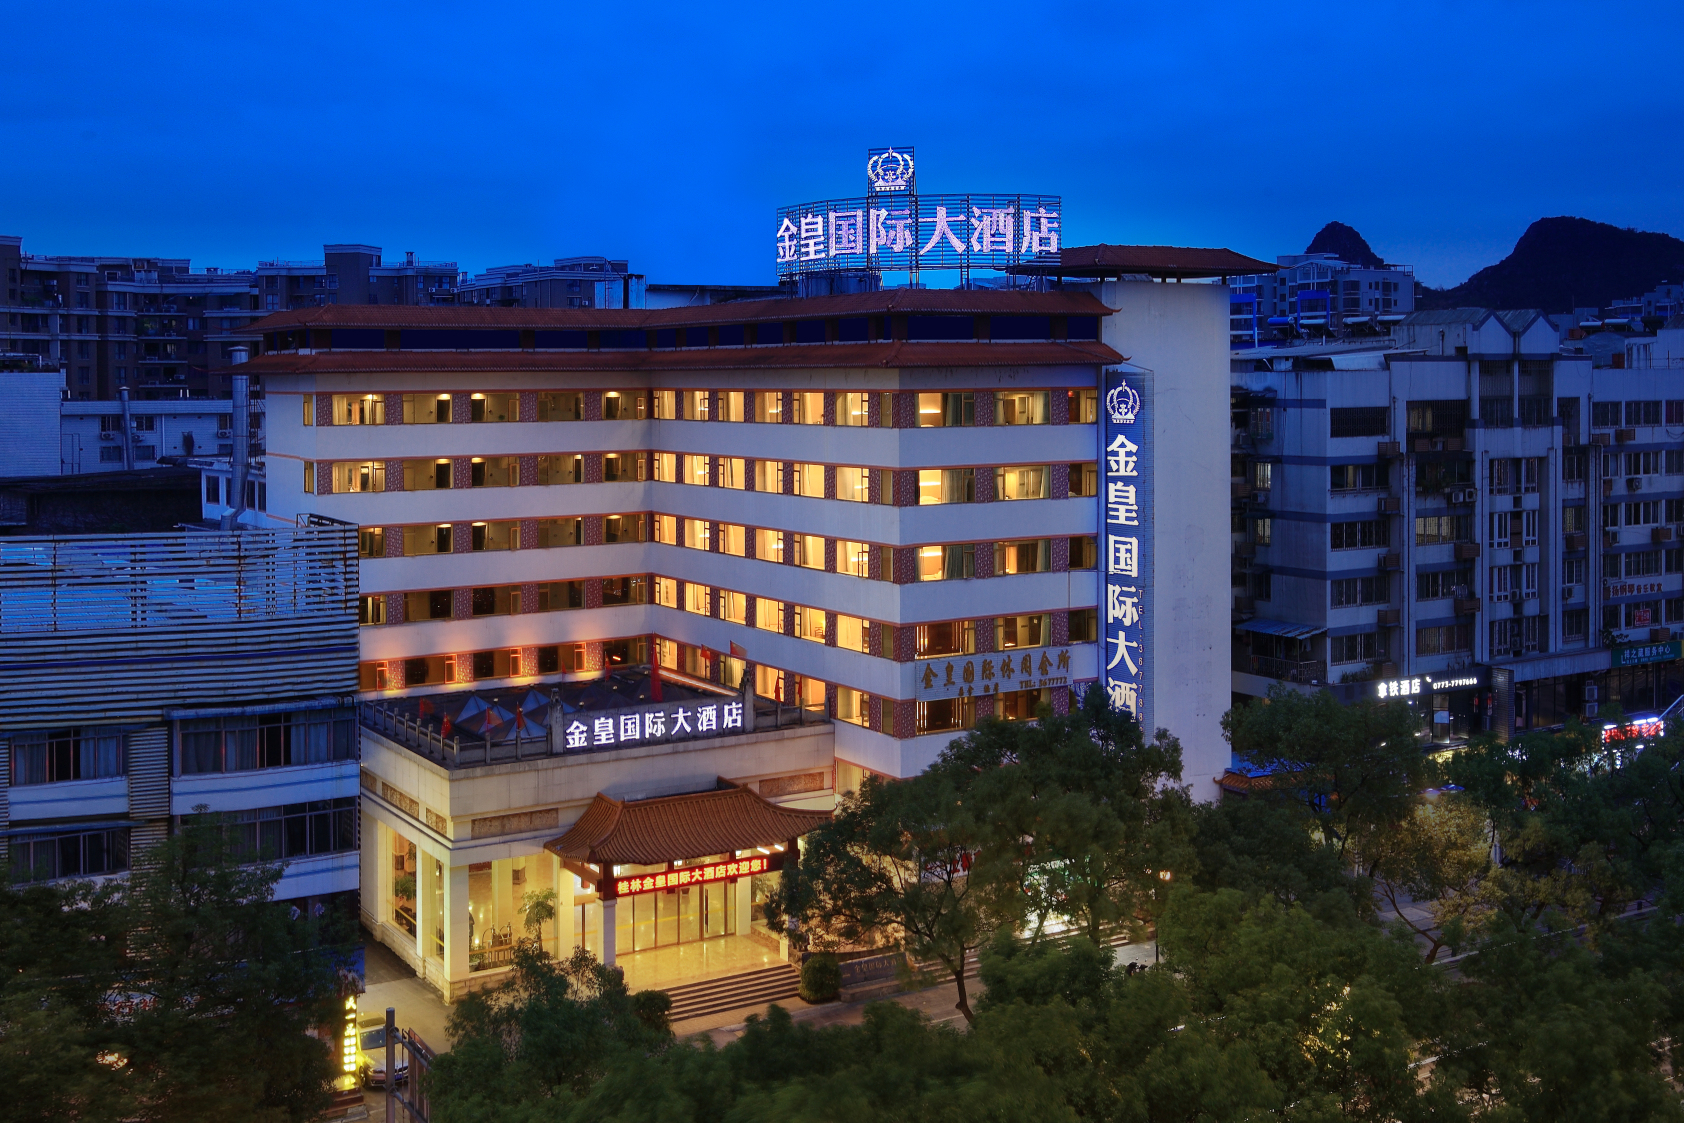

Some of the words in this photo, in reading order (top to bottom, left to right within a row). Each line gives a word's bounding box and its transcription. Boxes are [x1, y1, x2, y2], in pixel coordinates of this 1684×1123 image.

[777, 206, 1058, 262] 金皇国际大酒店
[1106, 434, 1140, 725] 金皇国际大酒
[1377, 678, 1421, 698] 拿铁酒店
[566, 701, 743, 749] 金皇国际大酒店
